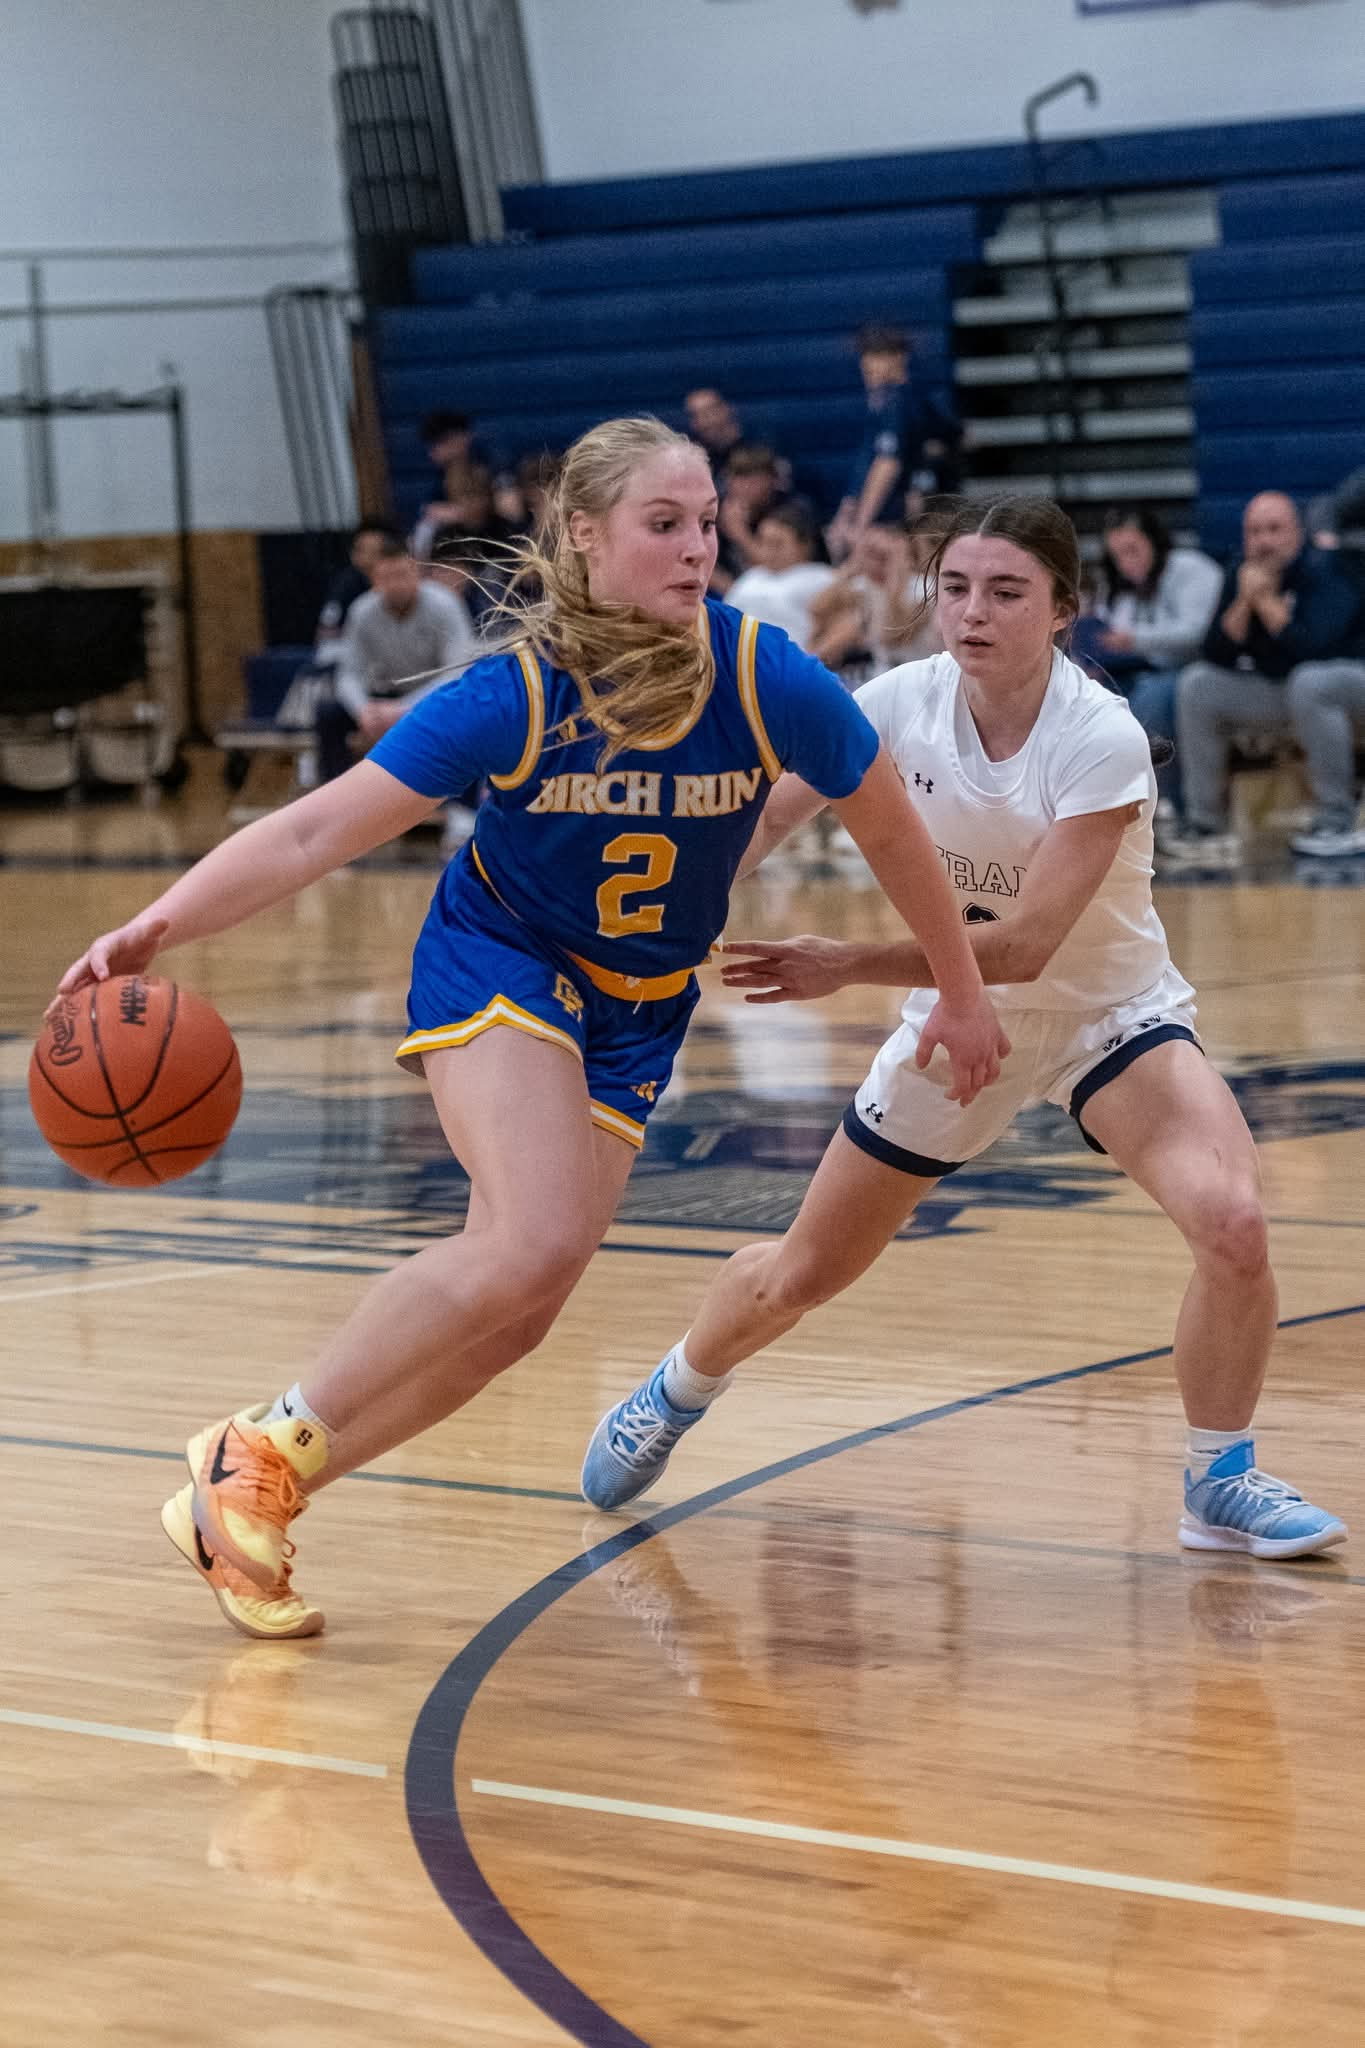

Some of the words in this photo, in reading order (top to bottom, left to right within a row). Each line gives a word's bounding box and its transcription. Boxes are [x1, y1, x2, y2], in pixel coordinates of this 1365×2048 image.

[526, 771, 662, 816] BIRCH
[672, 767, 763, 817] RUN
[596, 832, 678, 938] 2
